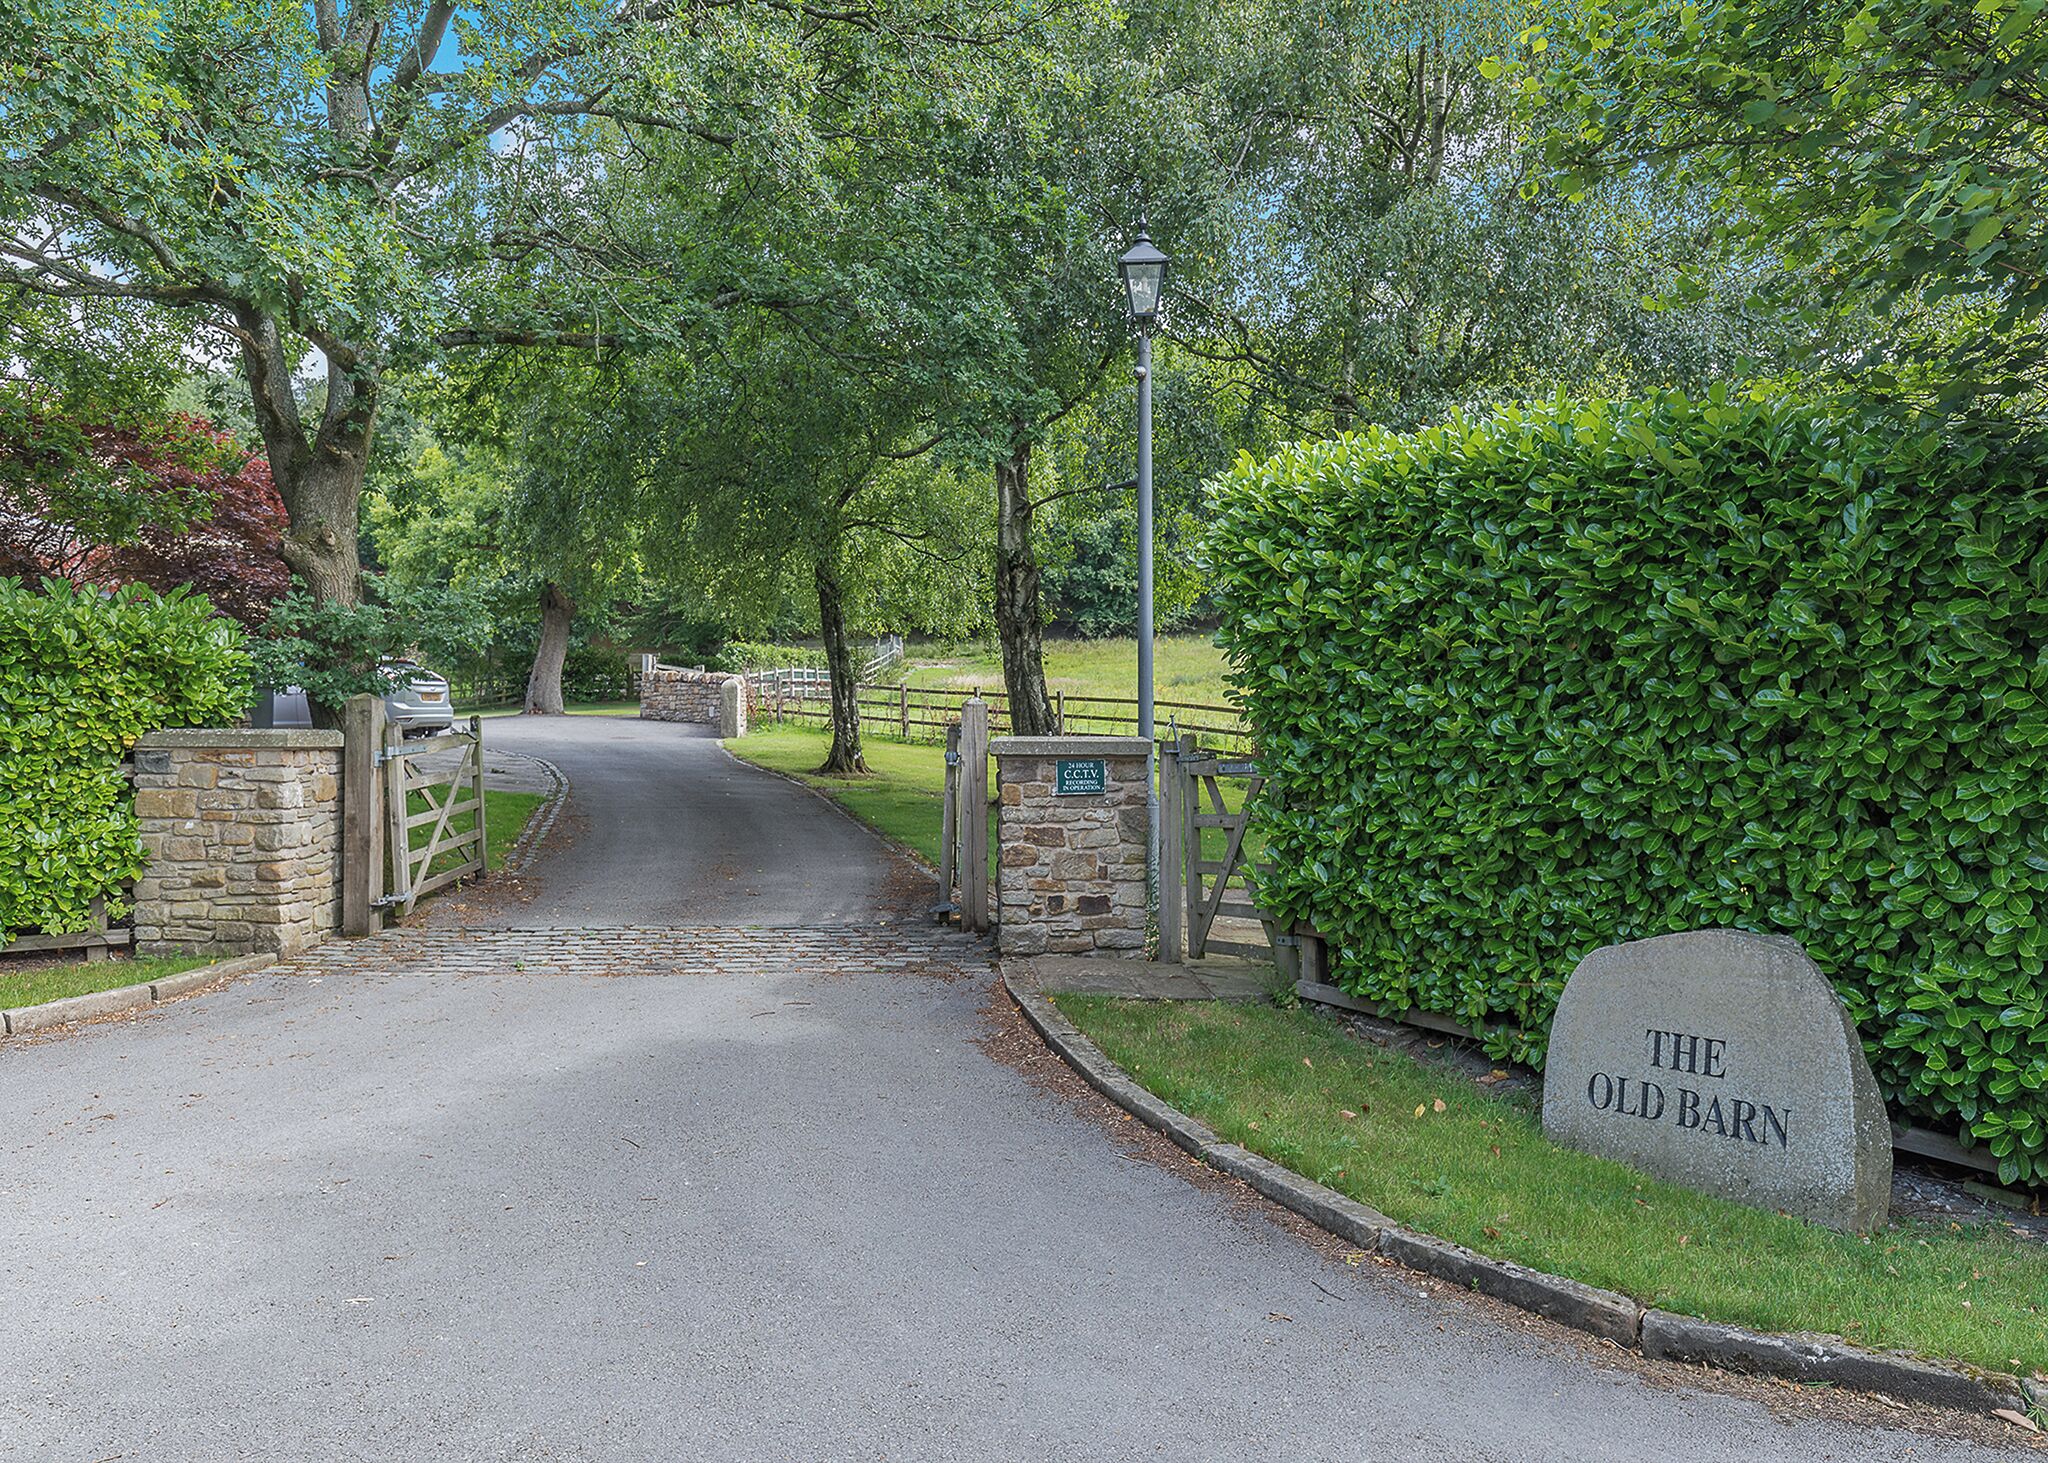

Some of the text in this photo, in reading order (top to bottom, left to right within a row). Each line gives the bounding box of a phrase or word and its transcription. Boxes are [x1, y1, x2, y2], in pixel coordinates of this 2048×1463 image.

[1064, 769, 1099, 779] C.C.T.V.
[1646, 1028, 1727, 1080] THE
[1587, 1071, 1792, 1151] OLD BARN
